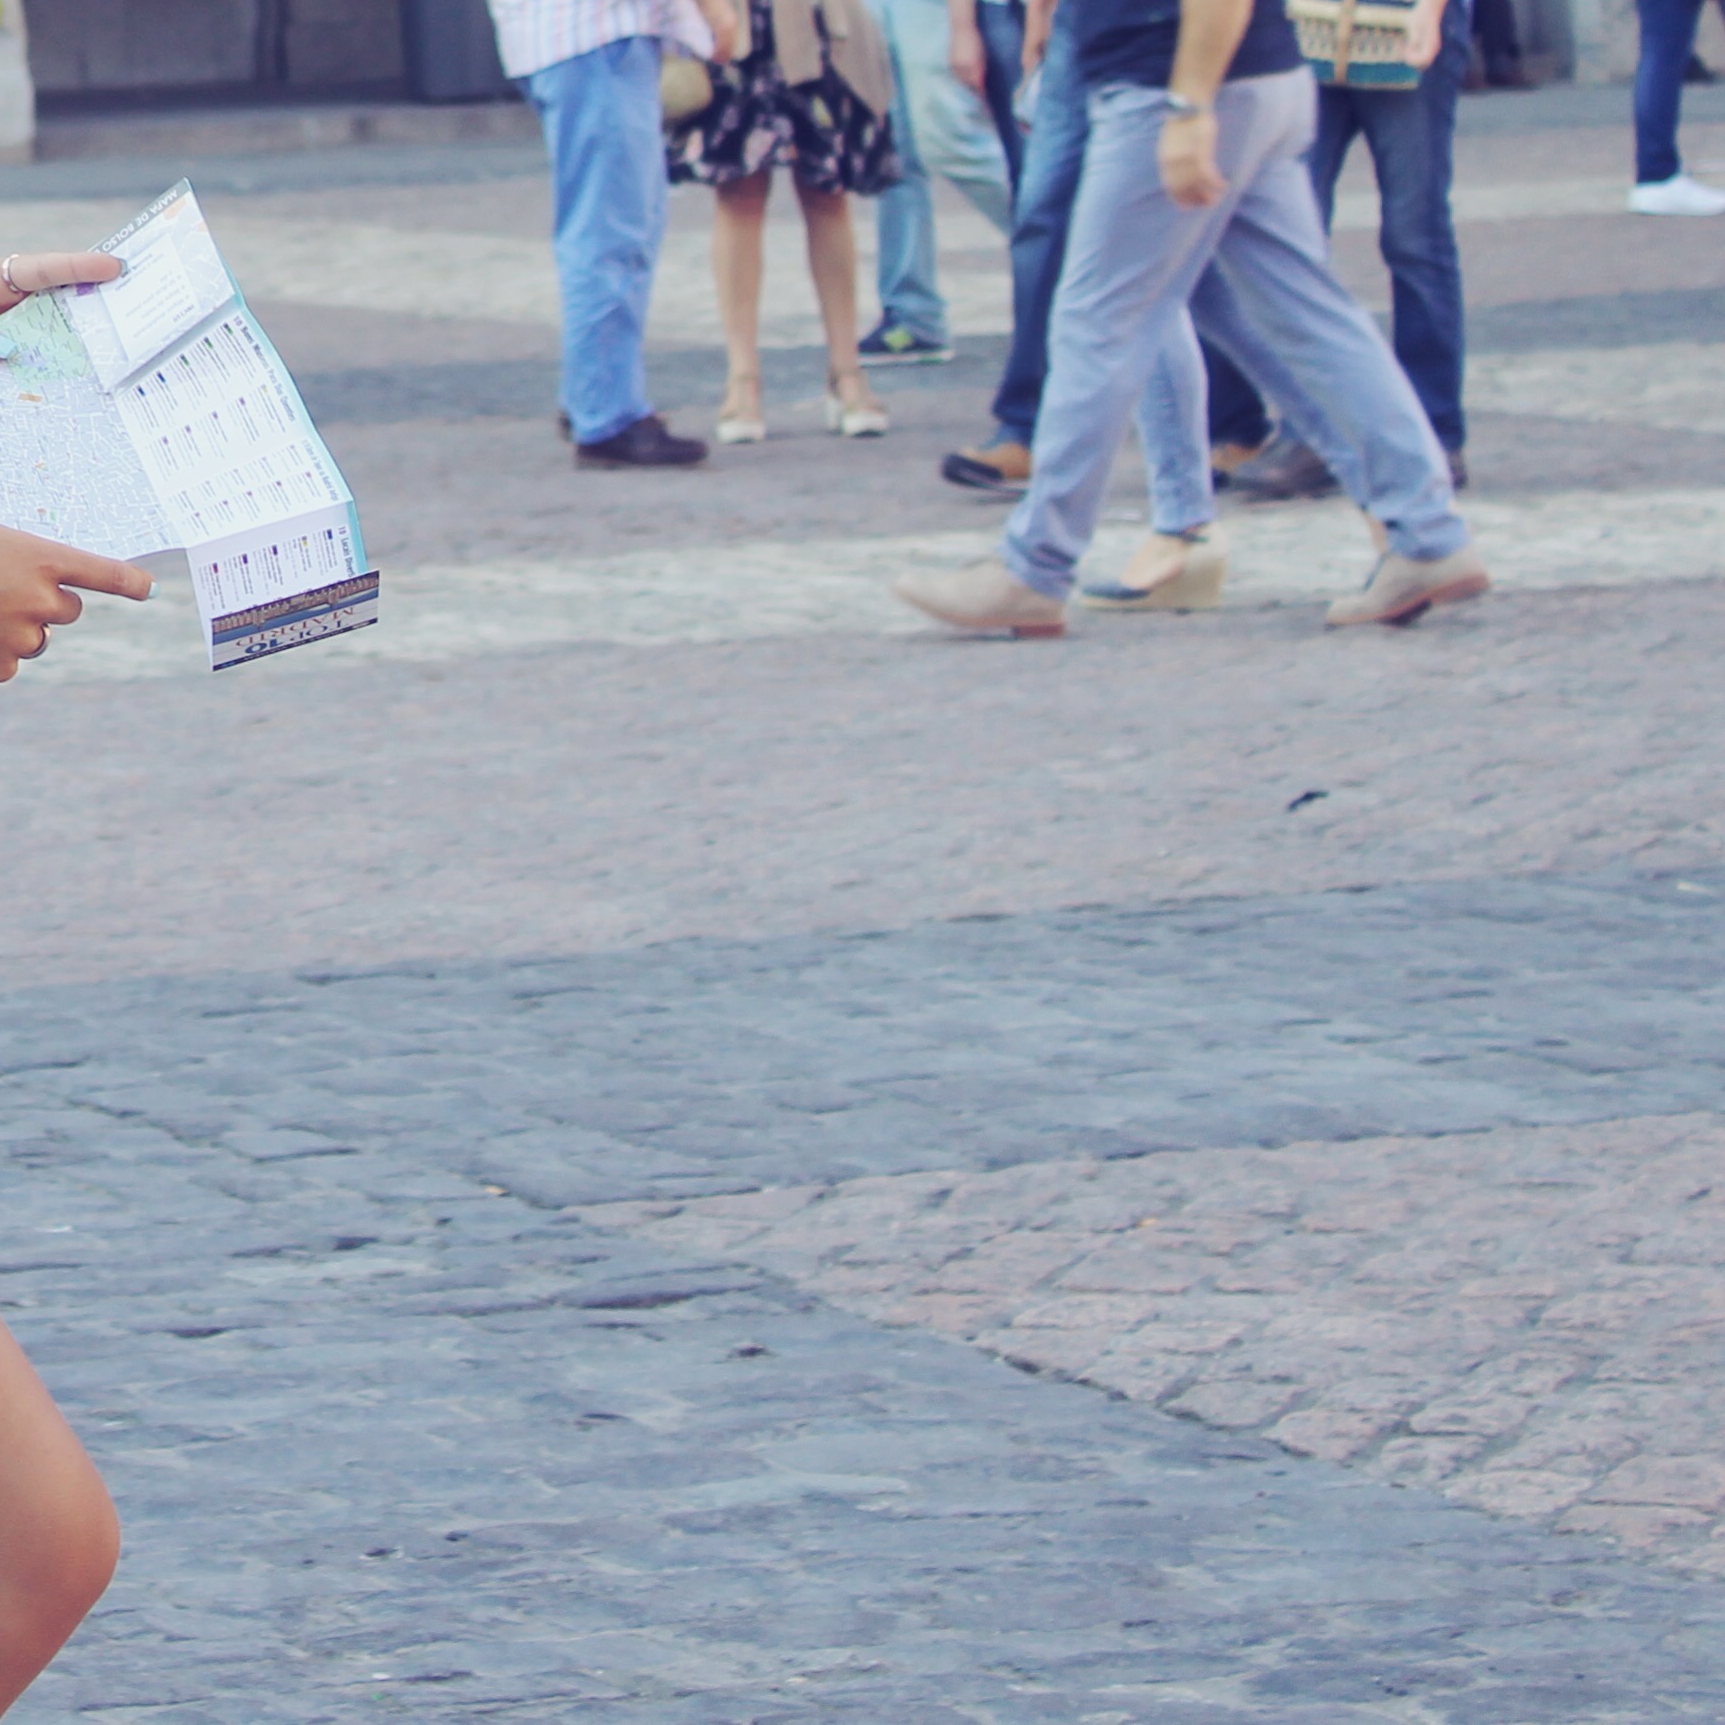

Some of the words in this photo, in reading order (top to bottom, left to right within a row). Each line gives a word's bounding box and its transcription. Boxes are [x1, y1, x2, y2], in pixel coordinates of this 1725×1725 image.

[149, 189, 179, 215] MAPA
[136, 213, 149, 225] DE
[102, 223, 135, 250] BOLSO
[236, 606, 354, 648] MADRID
[289, 619, 348, 641] TOP
[244, 637, 283, 655] 10
